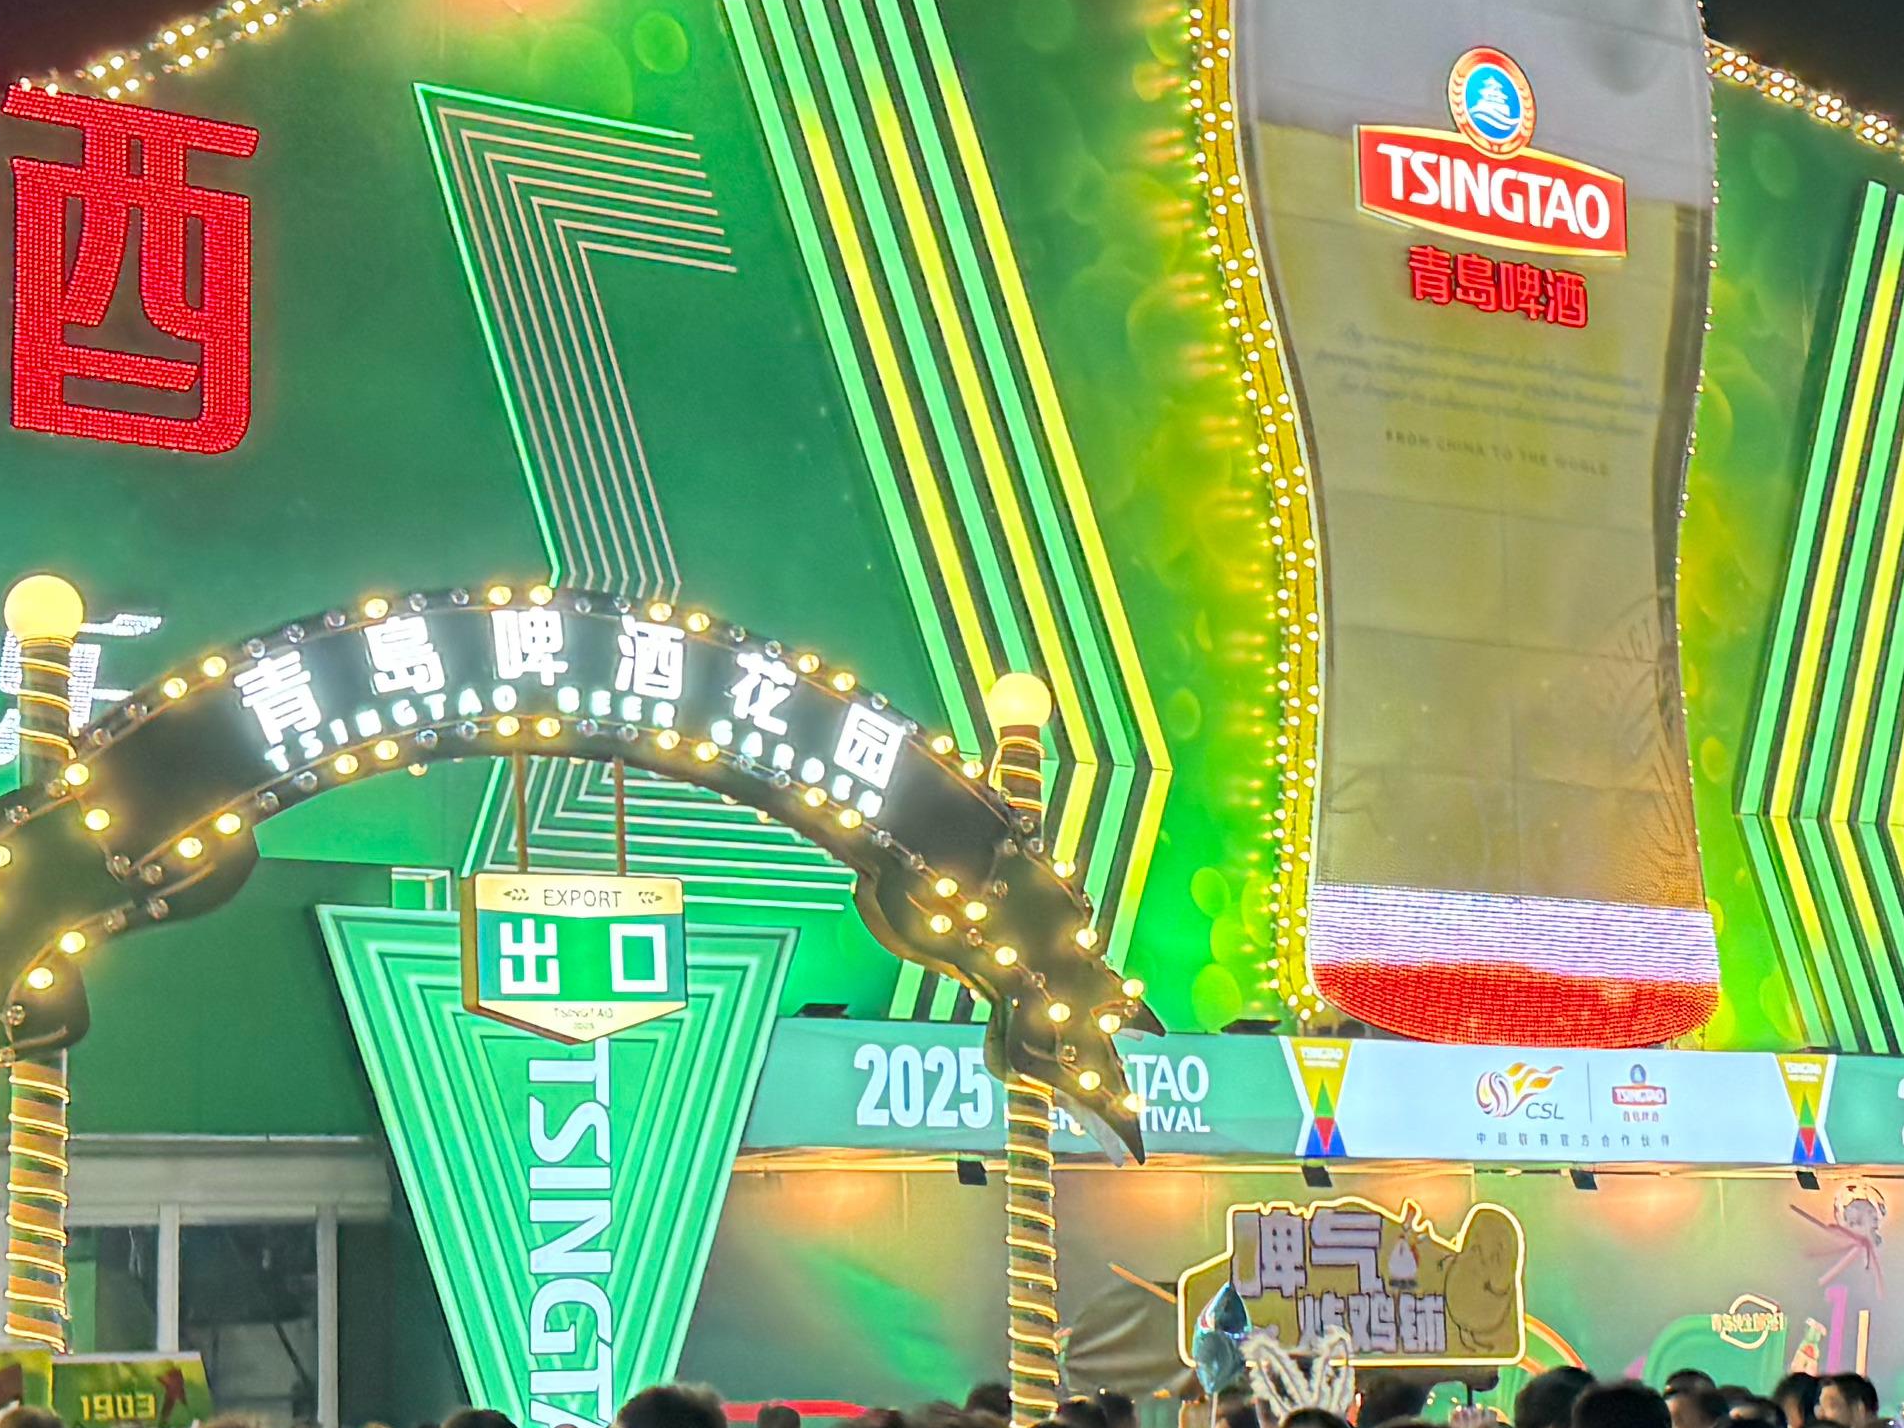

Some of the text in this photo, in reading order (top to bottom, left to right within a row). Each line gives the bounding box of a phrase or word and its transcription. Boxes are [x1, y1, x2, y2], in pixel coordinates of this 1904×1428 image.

[1376, 142, 1611, 240] TSINGTAO
[264, 684, 884, 819] TSINGTAO BEER GARDEN
[542, 888, 623, 908] EXPORT
[499, 918, 668, 995] 出口
[853, 1043, 994, 1130] 2025
[1525, 1102, 1566, 1121] CSL
[80, 1392, 157, 1421] 1903
